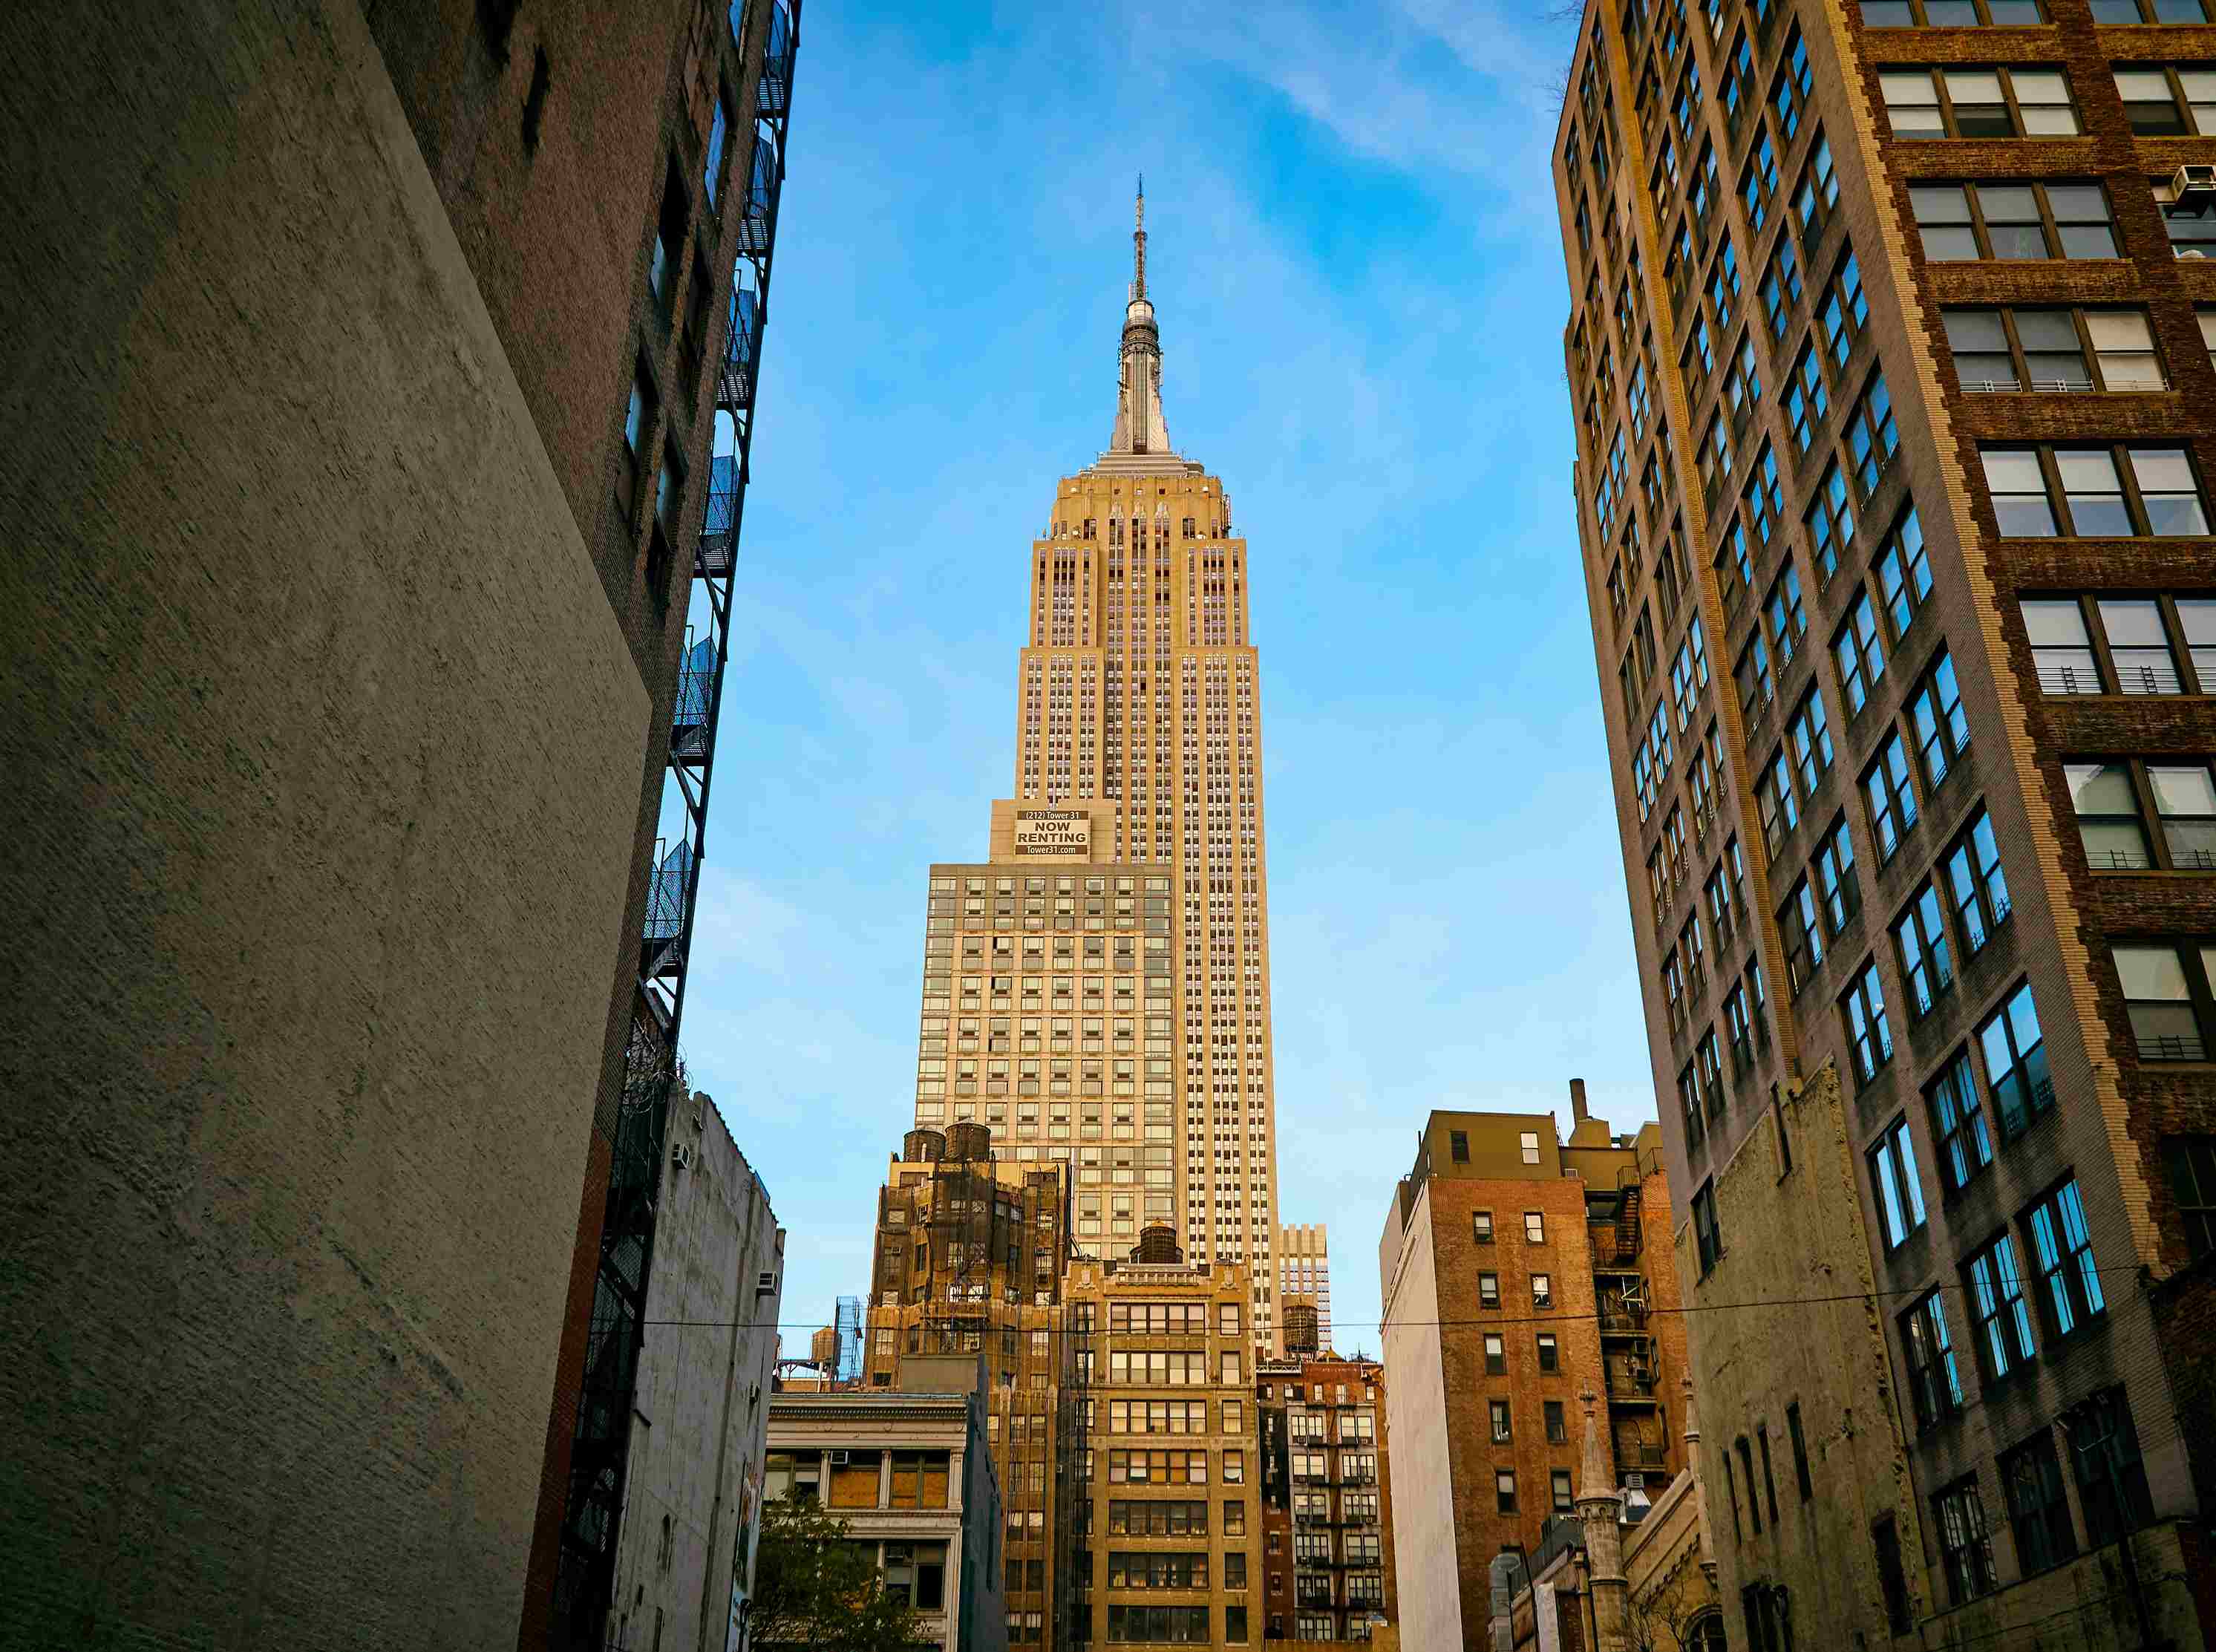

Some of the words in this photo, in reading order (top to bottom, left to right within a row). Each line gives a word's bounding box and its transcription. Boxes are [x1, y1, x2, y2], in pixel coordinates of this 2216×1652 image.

[1026, 811, 1045, 820] (212)
[1047, 811, 1069, 820] Tower
[1070, 811, 1079, 820] 31
[1035, 822, 1071, 831] NOW
[1017, 832, 1086, 843] RENTING
[1027, 846, 1076, 854] Tower31.com
